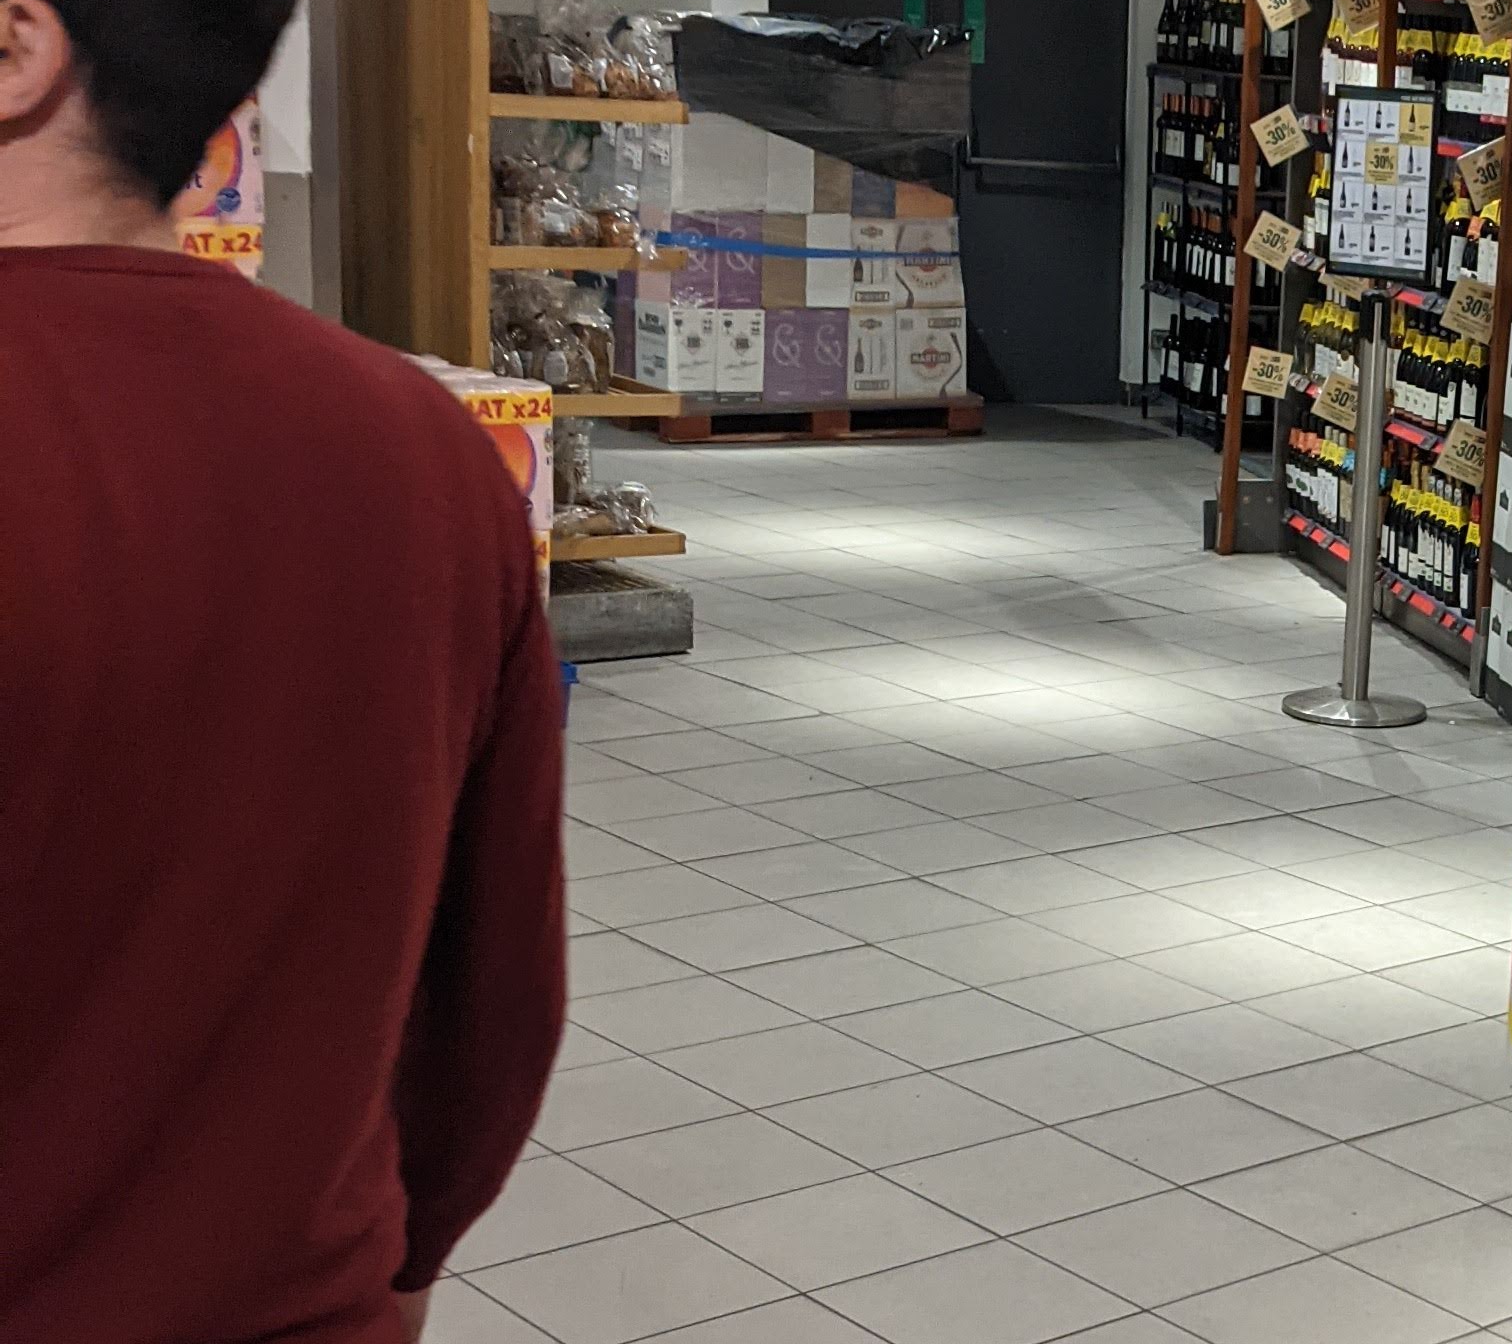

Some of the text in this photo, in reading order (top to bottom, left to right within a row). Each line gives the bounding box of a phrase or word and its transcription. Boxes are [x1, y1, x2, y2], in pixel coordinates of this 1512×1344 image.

[1265, 122, 1296, 146] -30%
[1369, 156, 1394, 170] -30%
[1258, 229, 1288, 254] -30%
[1457, 295, 1493, 322] -30%
[1252, 362, 1284, 382] -30%
[512, 397, 551, 418] x24
[1452, 440, 1485, 467] -30%
